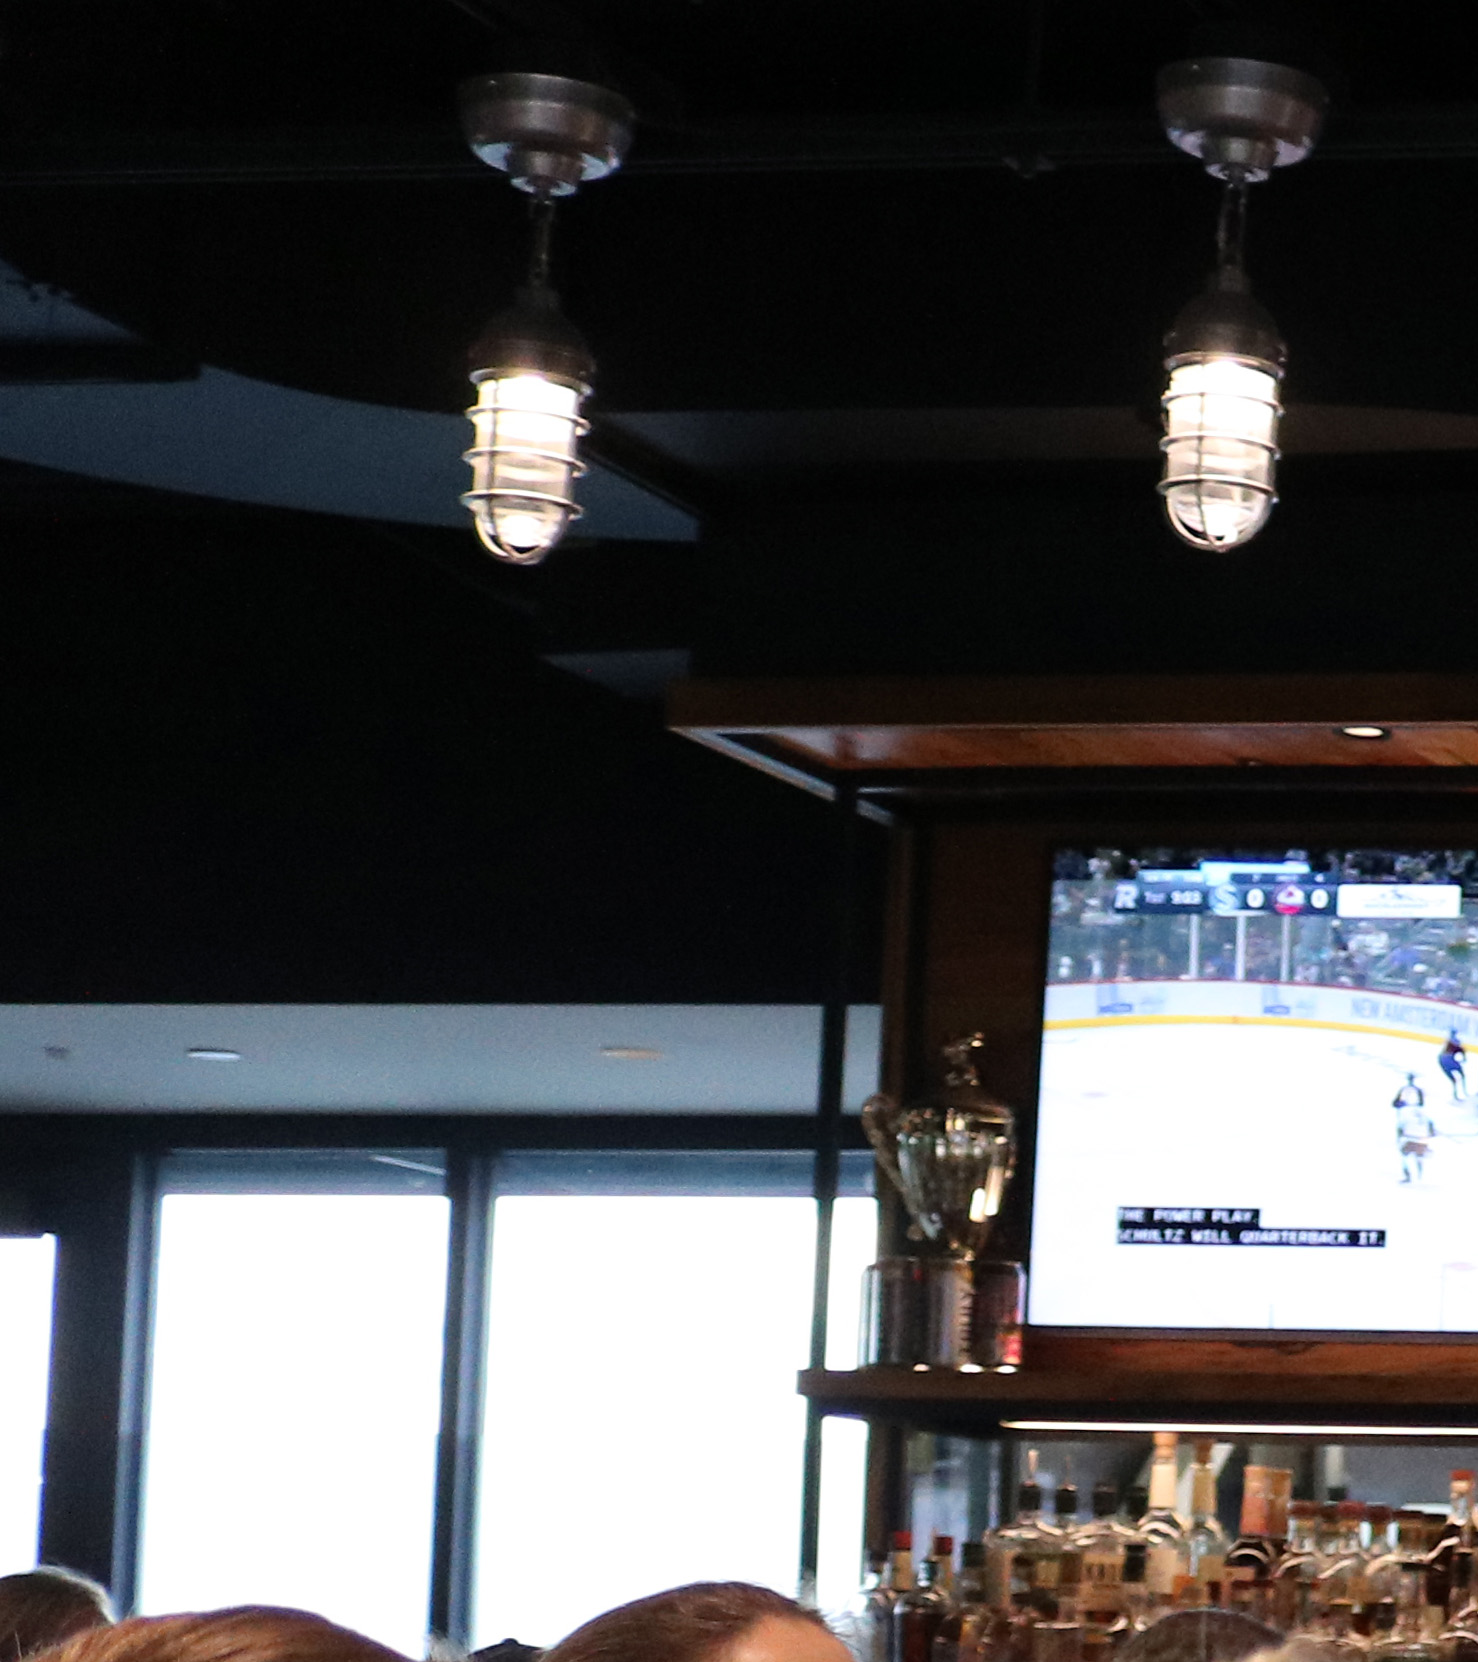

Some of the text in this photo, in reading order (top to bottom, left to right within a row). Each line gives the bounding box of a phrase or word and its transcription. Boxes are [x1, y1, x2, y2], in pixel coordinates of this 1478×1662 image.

[1350, 998, 1383, 1020] NEW
[1152, 1209, 1205, 1223] POWER
[1190, 1229, 1232, 1244] WILL
